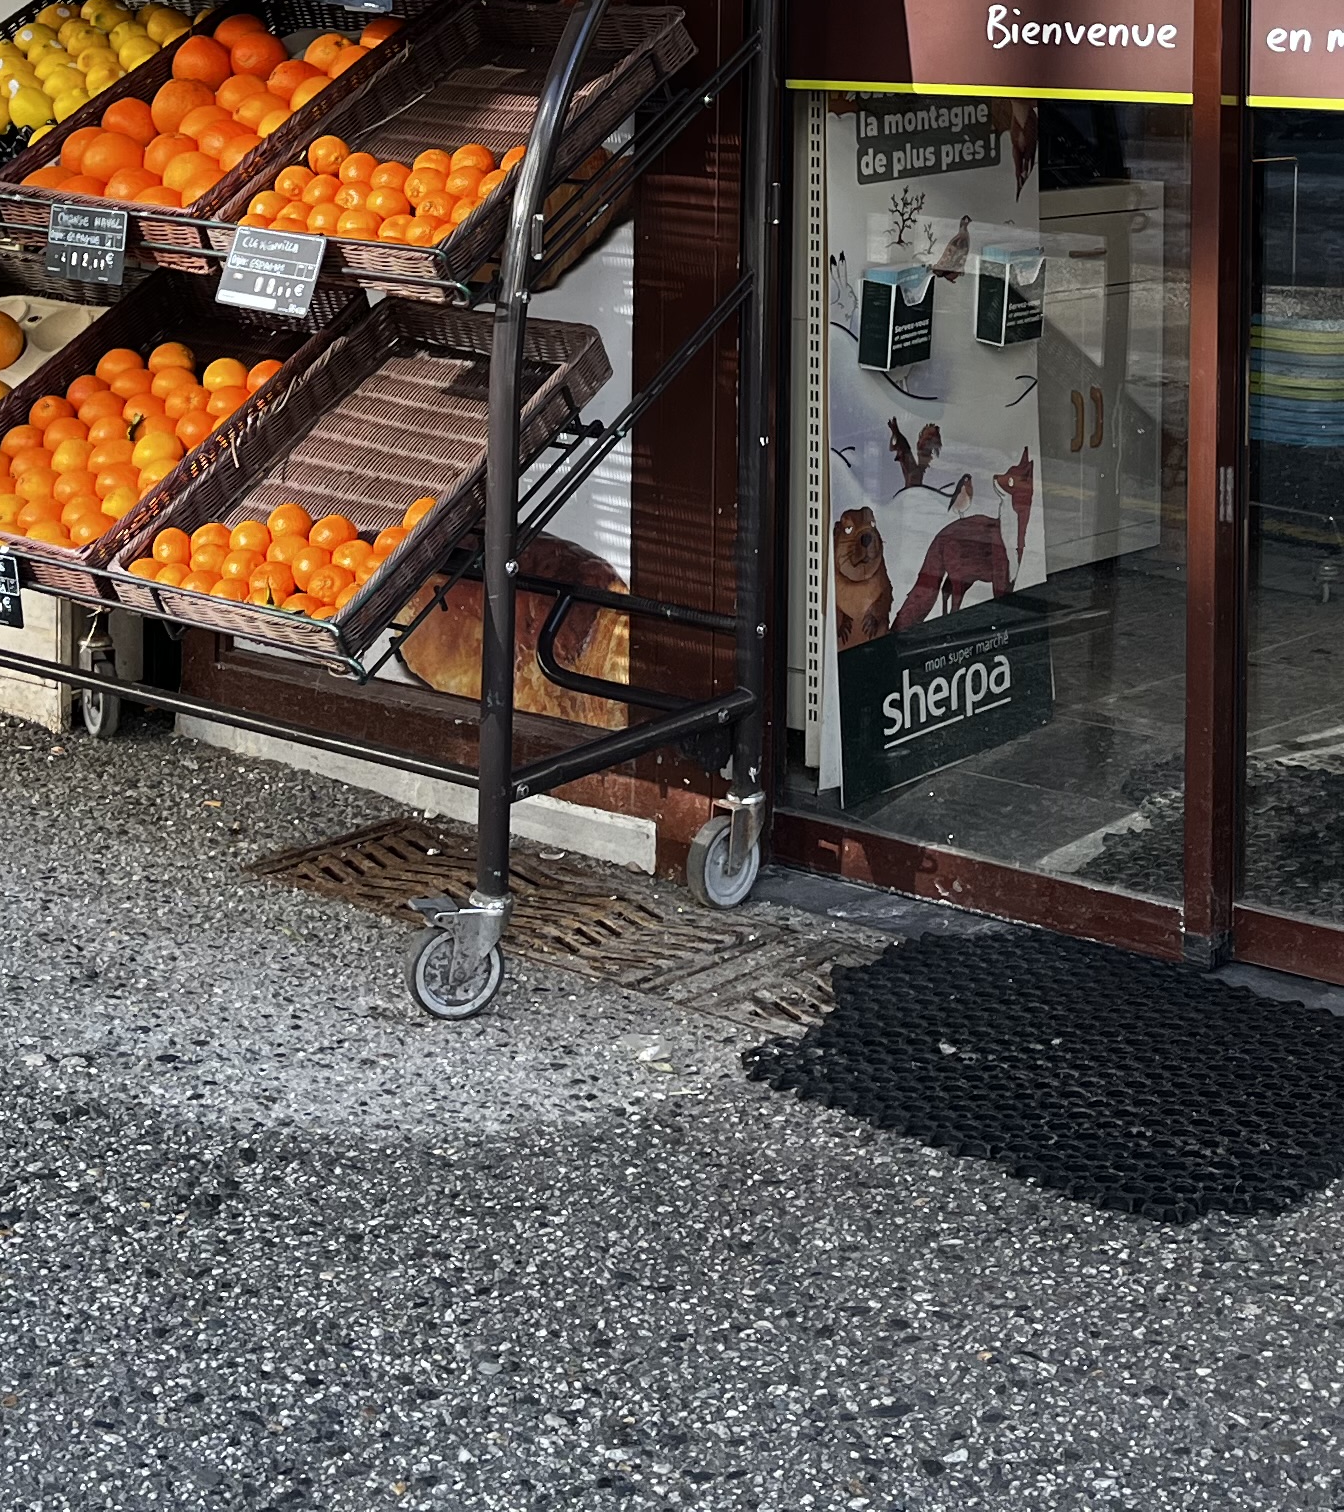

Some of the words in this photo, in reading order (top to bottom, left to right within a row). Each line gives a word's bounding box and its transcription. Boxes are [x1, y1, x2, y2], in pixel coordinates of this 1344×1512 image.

[986, 4, 1178, 49] Bienvenue
[1266, 27, 1312, 53] en
[860, 111, 878, 138] la
[884, 103, 989, 135] montagne
[861, 148, 887, 176] de
[892, 143, 935, 178] plus
[941, 134, 985, 171] près
[989, 133, 996, 158] !
[925, 655, 946, 672] mon
[948, 646, 974, 664] super
[976, 629, 1008, 654] marché
[882, 655, 1011, 736] sherpa
